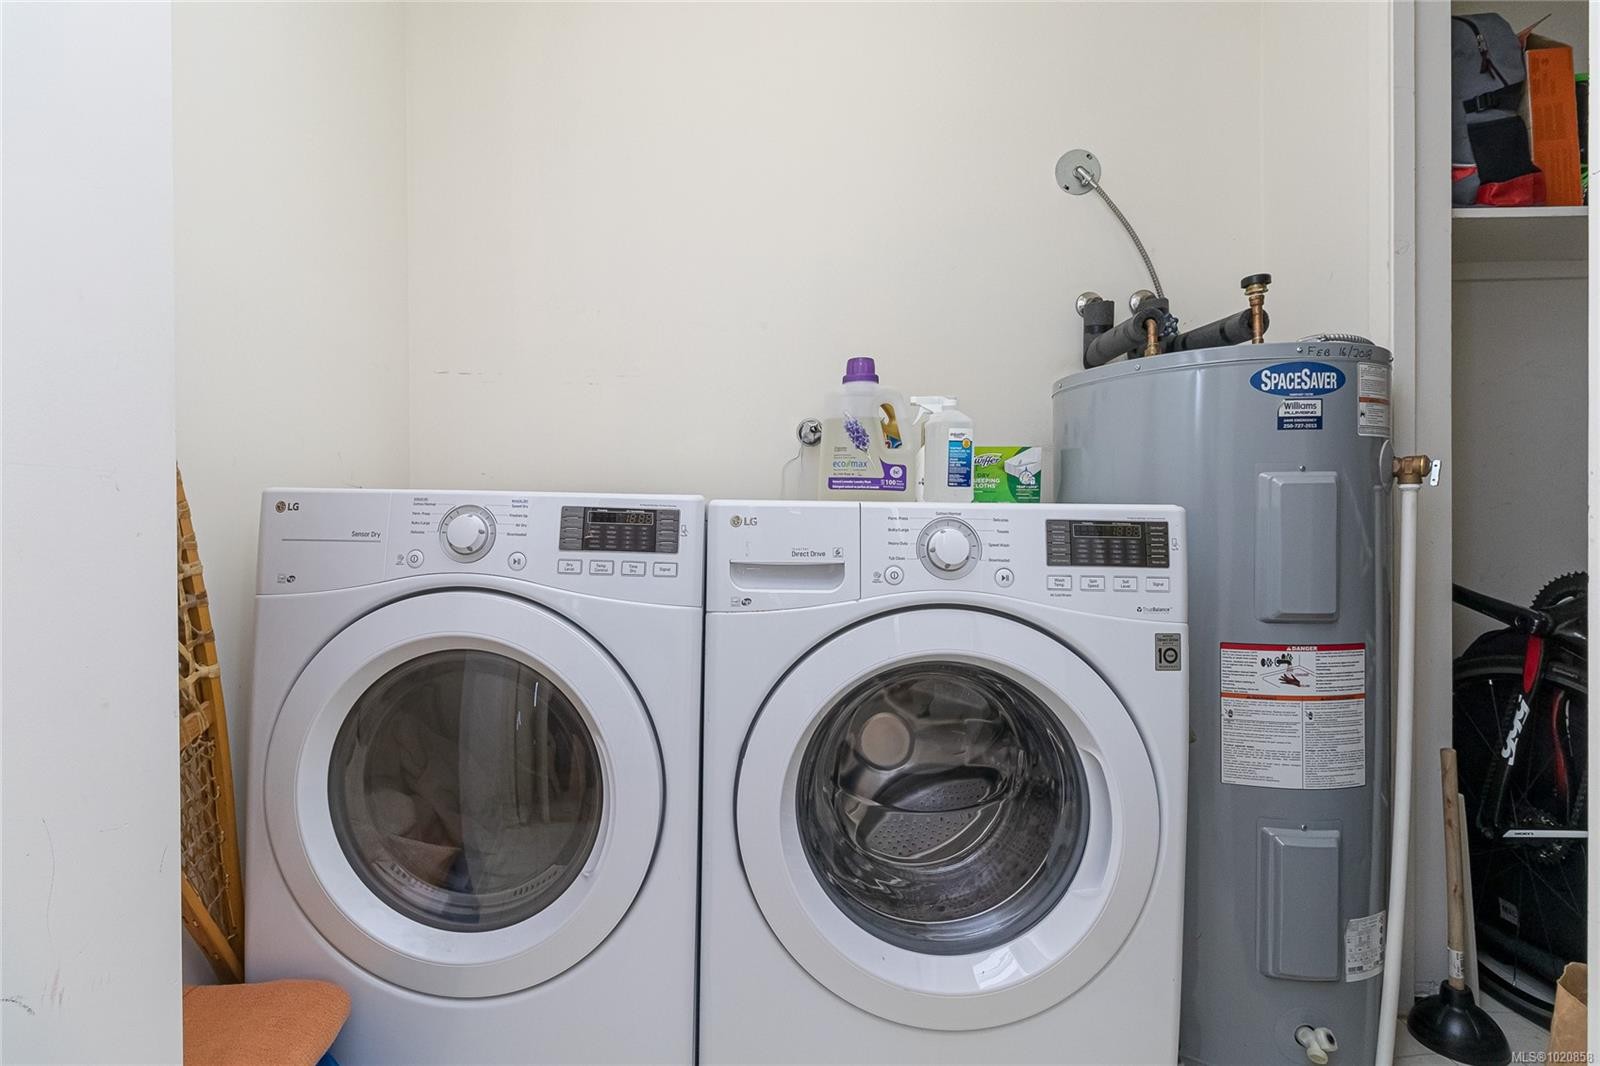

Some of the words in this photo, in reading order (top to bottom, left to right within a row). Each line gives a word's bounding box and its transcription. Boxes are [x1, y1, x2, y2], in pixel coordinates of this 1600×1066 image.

[1307, 345, 1330, 357] FEB
[1283, 401, 1317, 410] Williams
[974, 456, 1000, 466] wiffer
[287, 502, 300, 511] LG
[744, 517, 758, 526] LG
[351, 530, 370, 538] Sensor
[370, 530, 381, 539] Dry
[1158, 647, 1178, 665] 10
